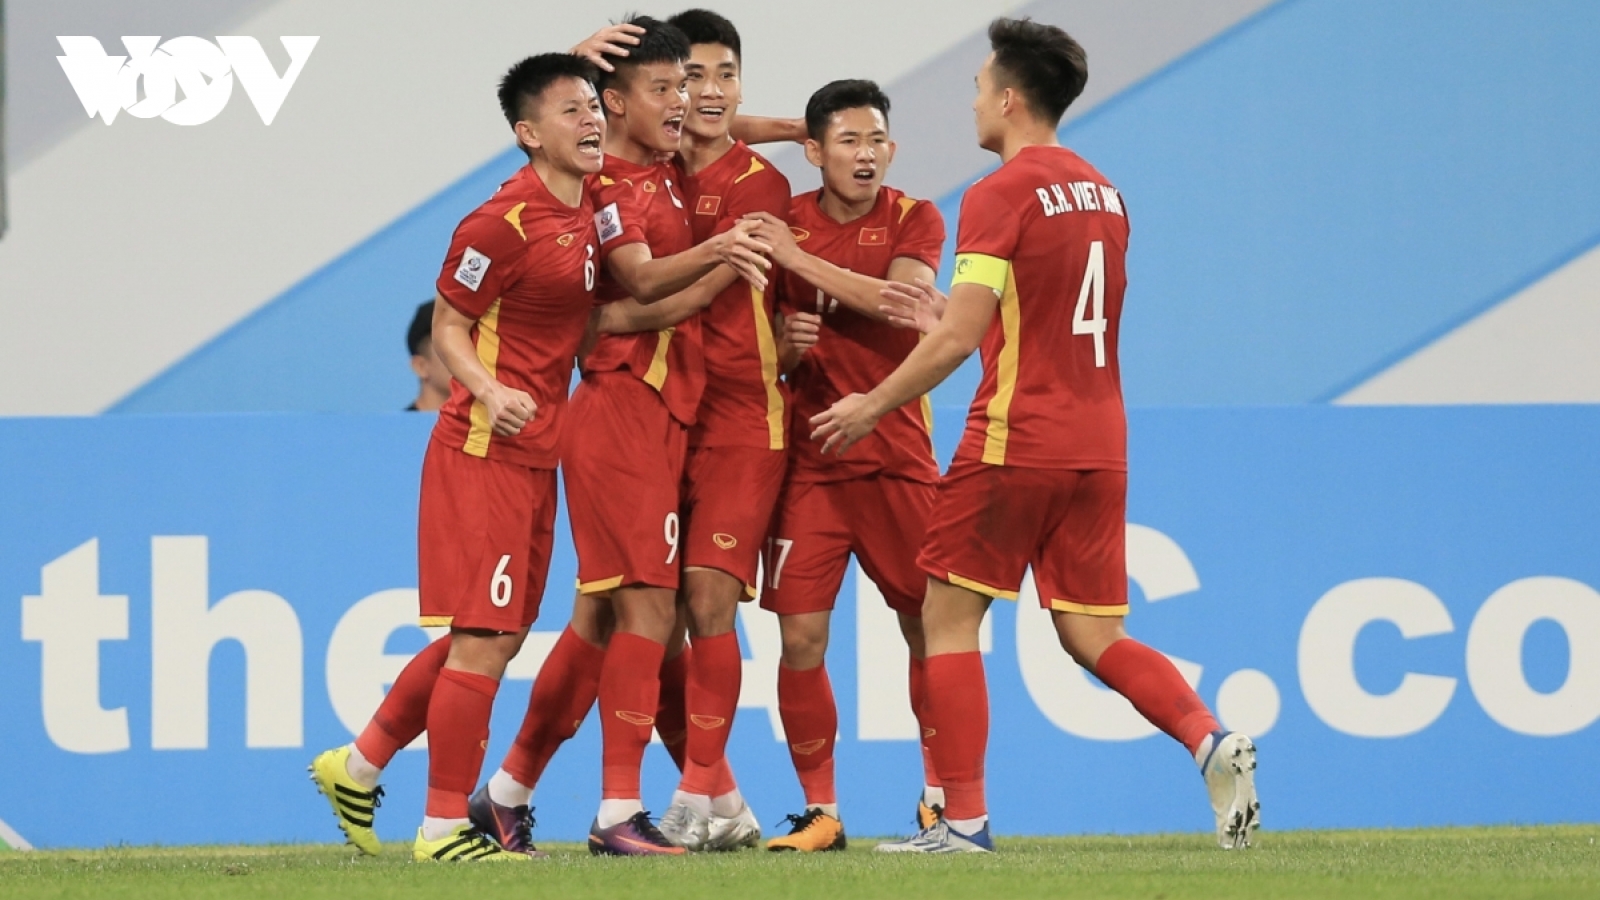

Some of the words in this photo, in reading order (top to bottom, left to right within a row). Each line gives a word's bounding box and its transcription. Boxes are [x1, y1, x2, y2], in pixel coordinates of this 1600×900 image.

[1035, 183, 1073, 217] B.H.
[1067, 180, 1101, 212] VIET
[1072, 240, 1107, 367] 4
[664, 511, 680, 565] 9
[767, 536, 793, 590] 17
[489, 554, 513, 608] 6
